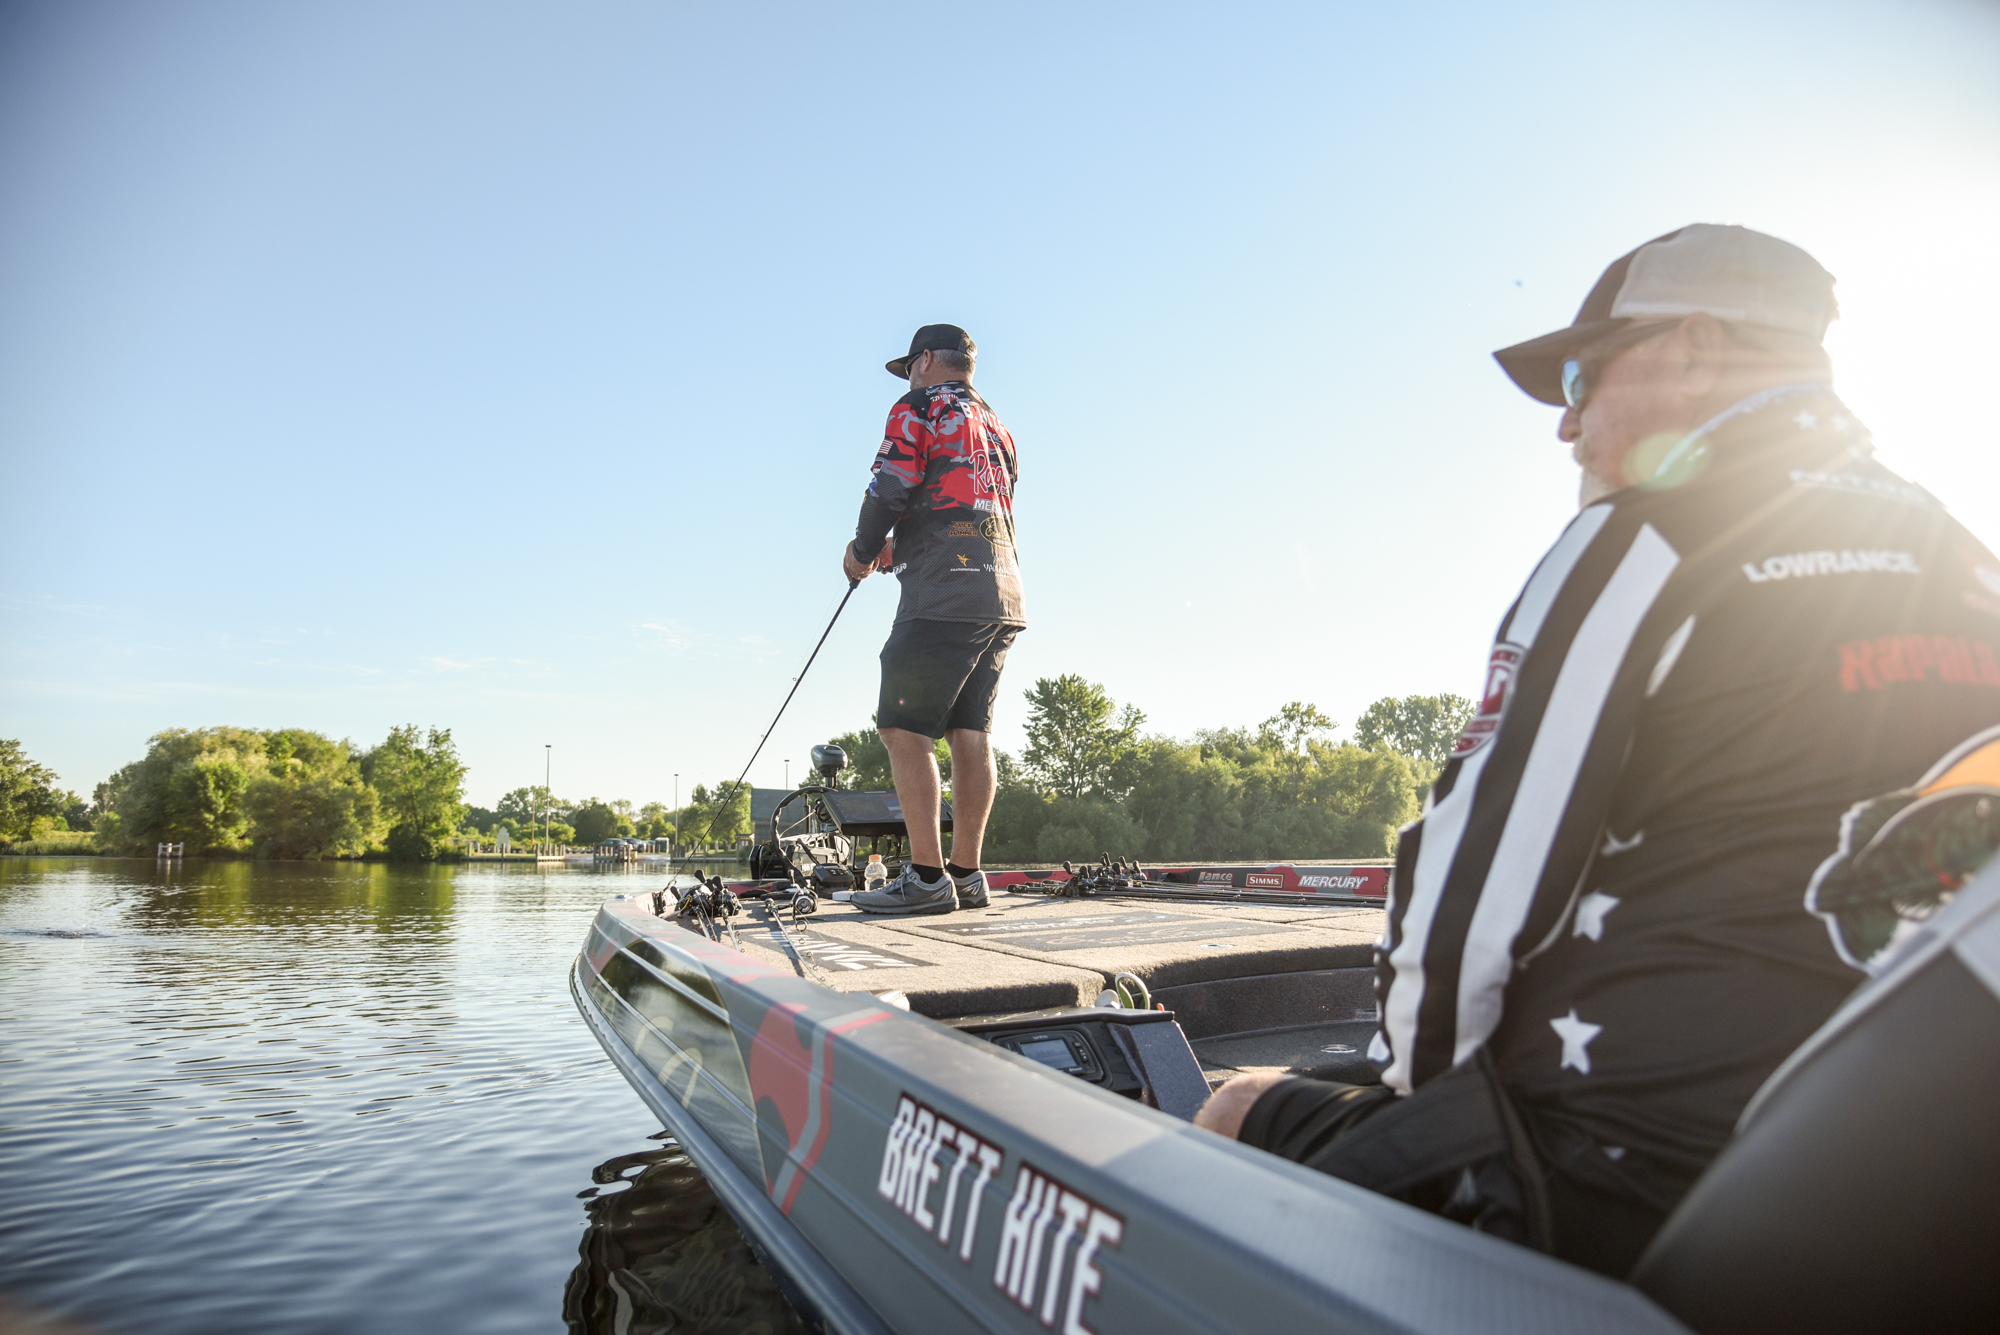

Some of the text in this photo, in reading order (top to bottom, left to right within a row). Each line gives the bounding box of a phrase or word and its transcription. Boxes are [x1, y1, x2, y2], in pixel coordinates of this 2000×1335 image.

[1741, 549, 1922, 582] LOWRANCE
[1249, 876, 1279, 885] SIMMS
[879, 1092, 1126, 1335] BRETT HITE
